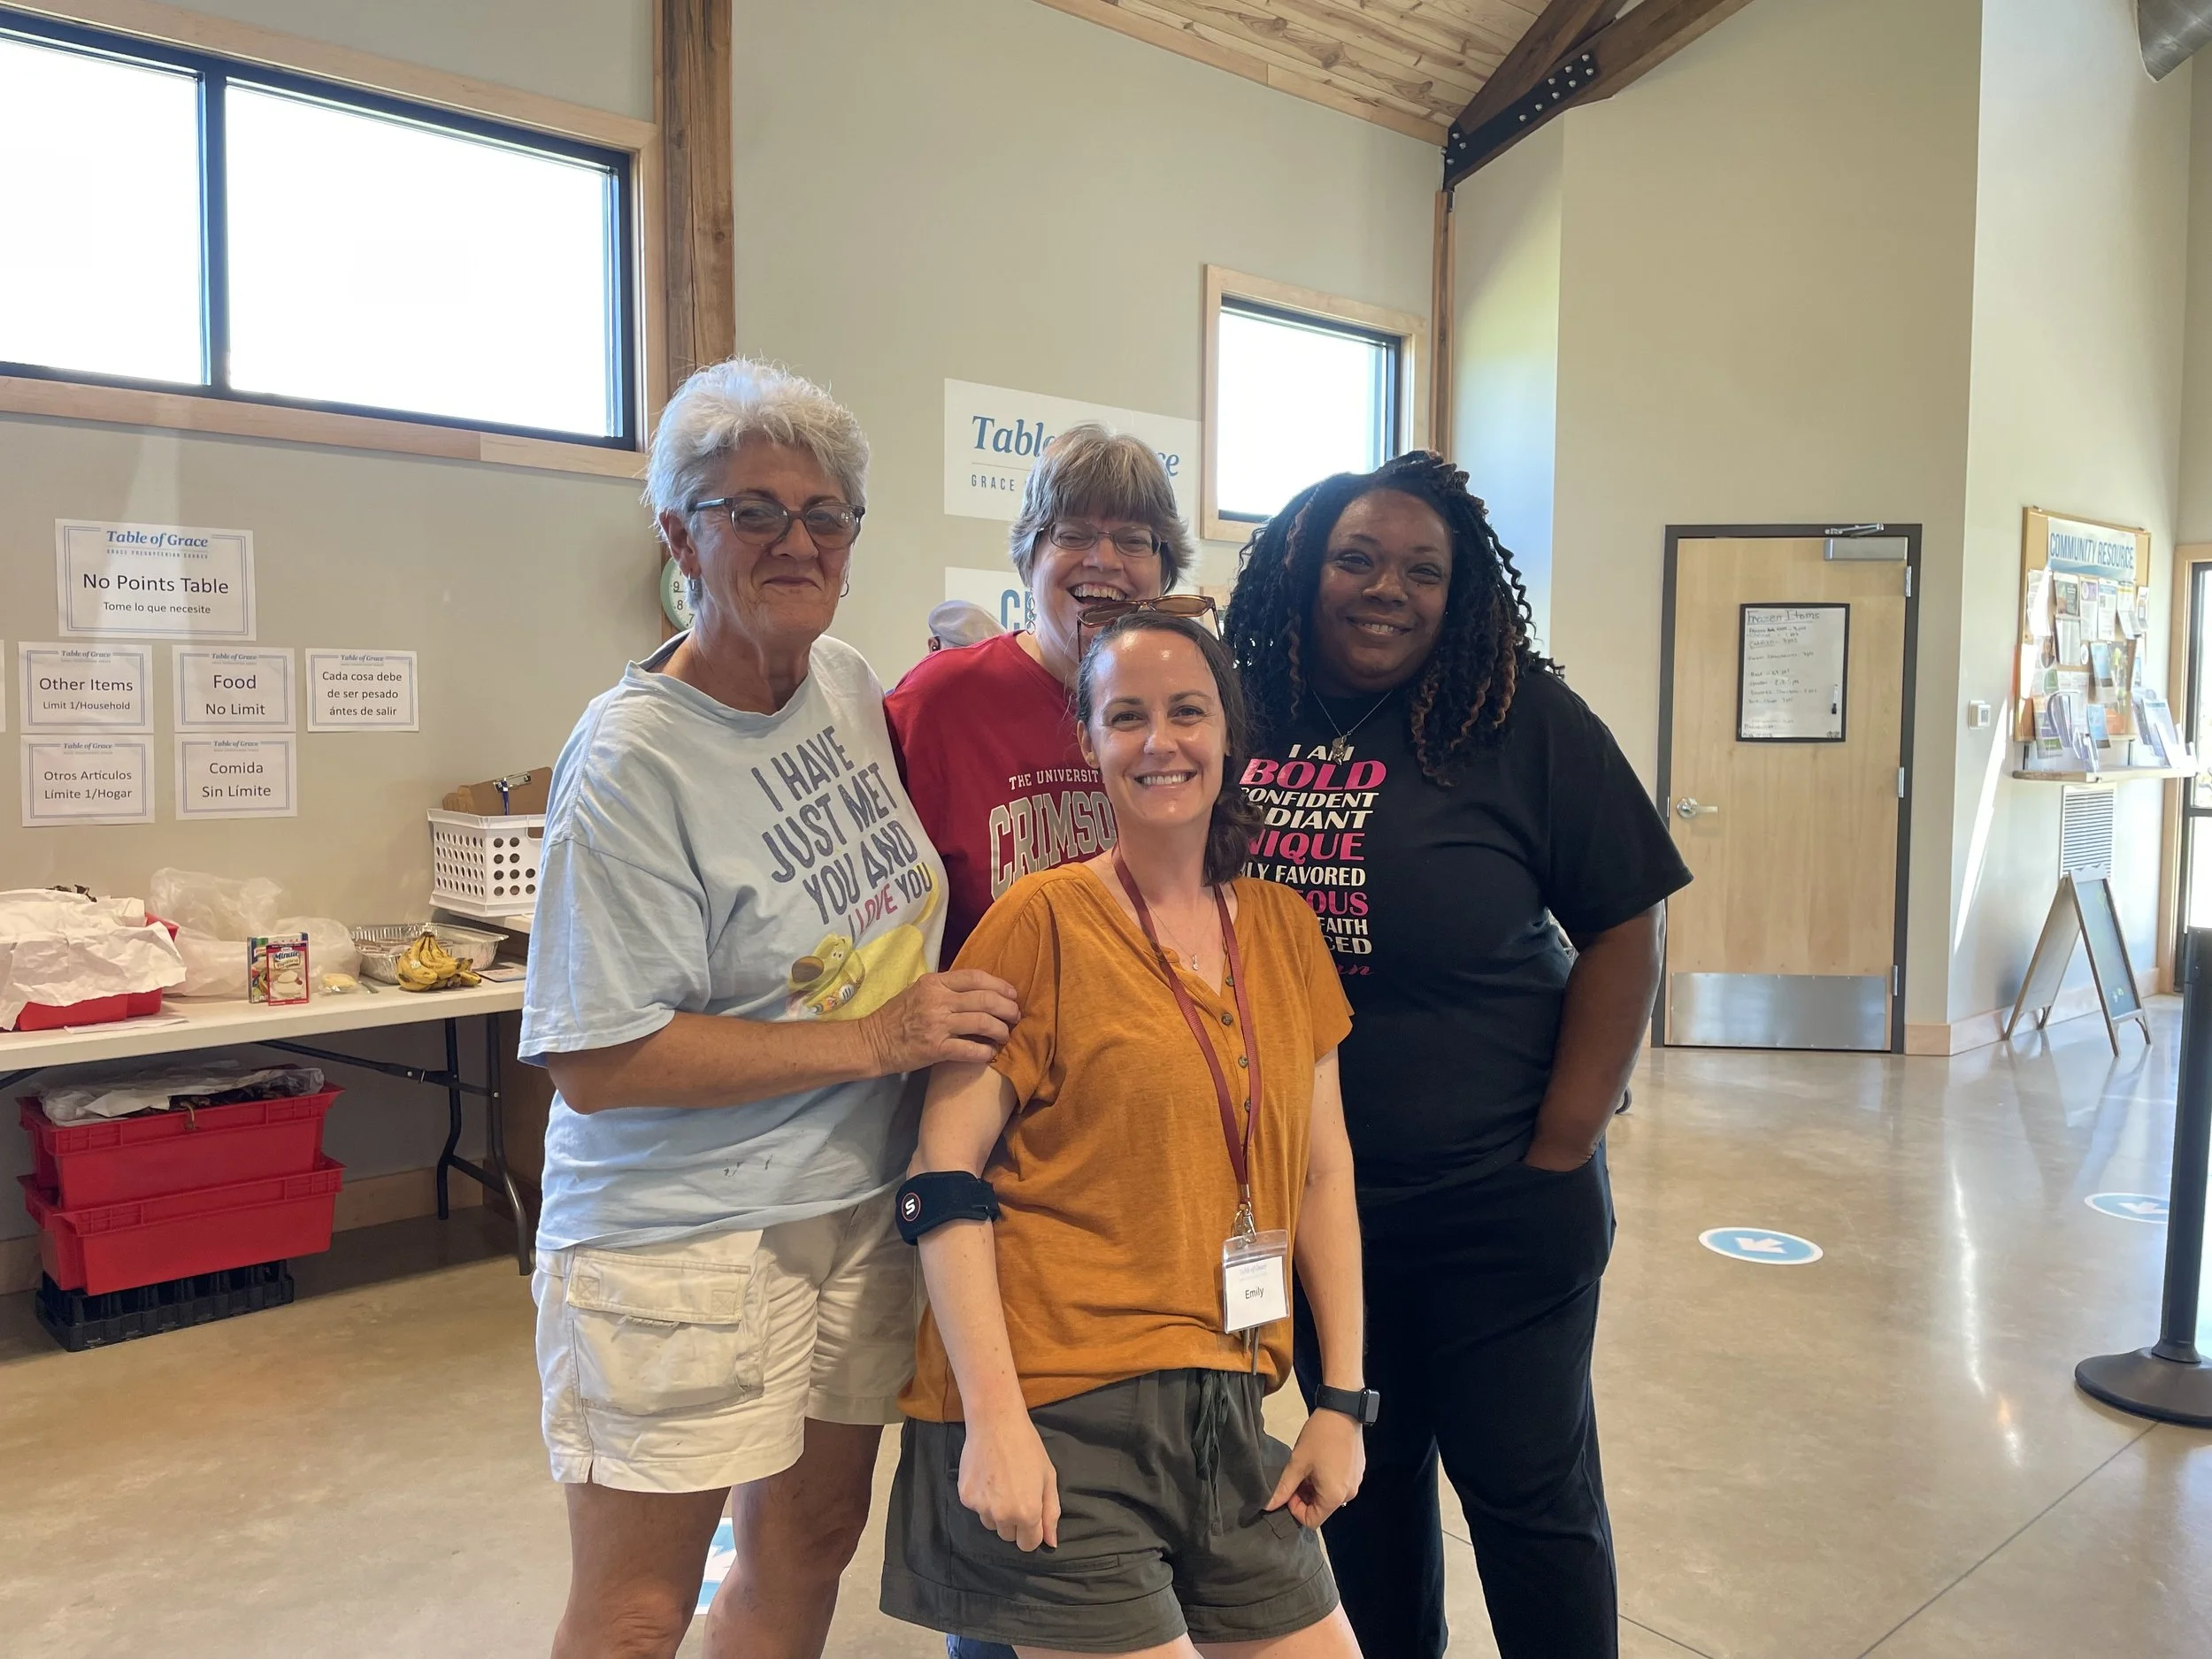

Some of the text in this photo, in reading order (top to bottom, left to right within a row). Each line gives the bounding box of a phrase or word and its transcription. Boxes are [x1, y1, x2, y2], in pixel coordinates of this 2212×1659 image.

[972, 474, 1015, 491] GRACE
[106, 530, 209, 548] Table of Grace
[2049, 533, 2097, 564] COMMUNITY
[83, 573, 229, 594] No Points Table
[104, 602, 211, 614] Tome lo que necesite
[677, 600, 683, 611] 8
[39, 677, 134, 691] Other Items
[213, 674, 257, 689] Food
[322, 672, 348, 681] Cada
[376, 672, 403, 681] debe
[327, 688, 341, 698] de
[362, 689, 399, 700] pesado
[42, 701, 131, 710] Limit 1/Household
[205, 703, 265, 715] No Limit
[329, 706, 397, 716] ántes de salir
[1288, 744, 1302, 758] I
[44, 770, 132, 780] Otros Artículos
[209, 761, 264, 774] Comida
[751, 726, 855, 812] I HAVE
[1239, 757, 1387, 791] BOLD
[1009, 768, 1102, 790] THE UNIVERSIT
[44, 787, 132, 801] Límite 1/Hogar
[202, 785, 272, 798] Sin Límite
[761, 762, 897, 884] JUST MET
[1263, 810, 1373, 830] DIANT
[988, 790, 1118, 902] CRIMSO
[1248, 829, 1365, 864] NIQUE
[803, 819, 918, 926] YOU AND
[1275, 864, 1366, 887] FAVORED
[848, 861, 933, 941] I LOVE YOU
[1325, 934, 1372, 955] CED
[1245, 1286, 1264, 1299] Emily
